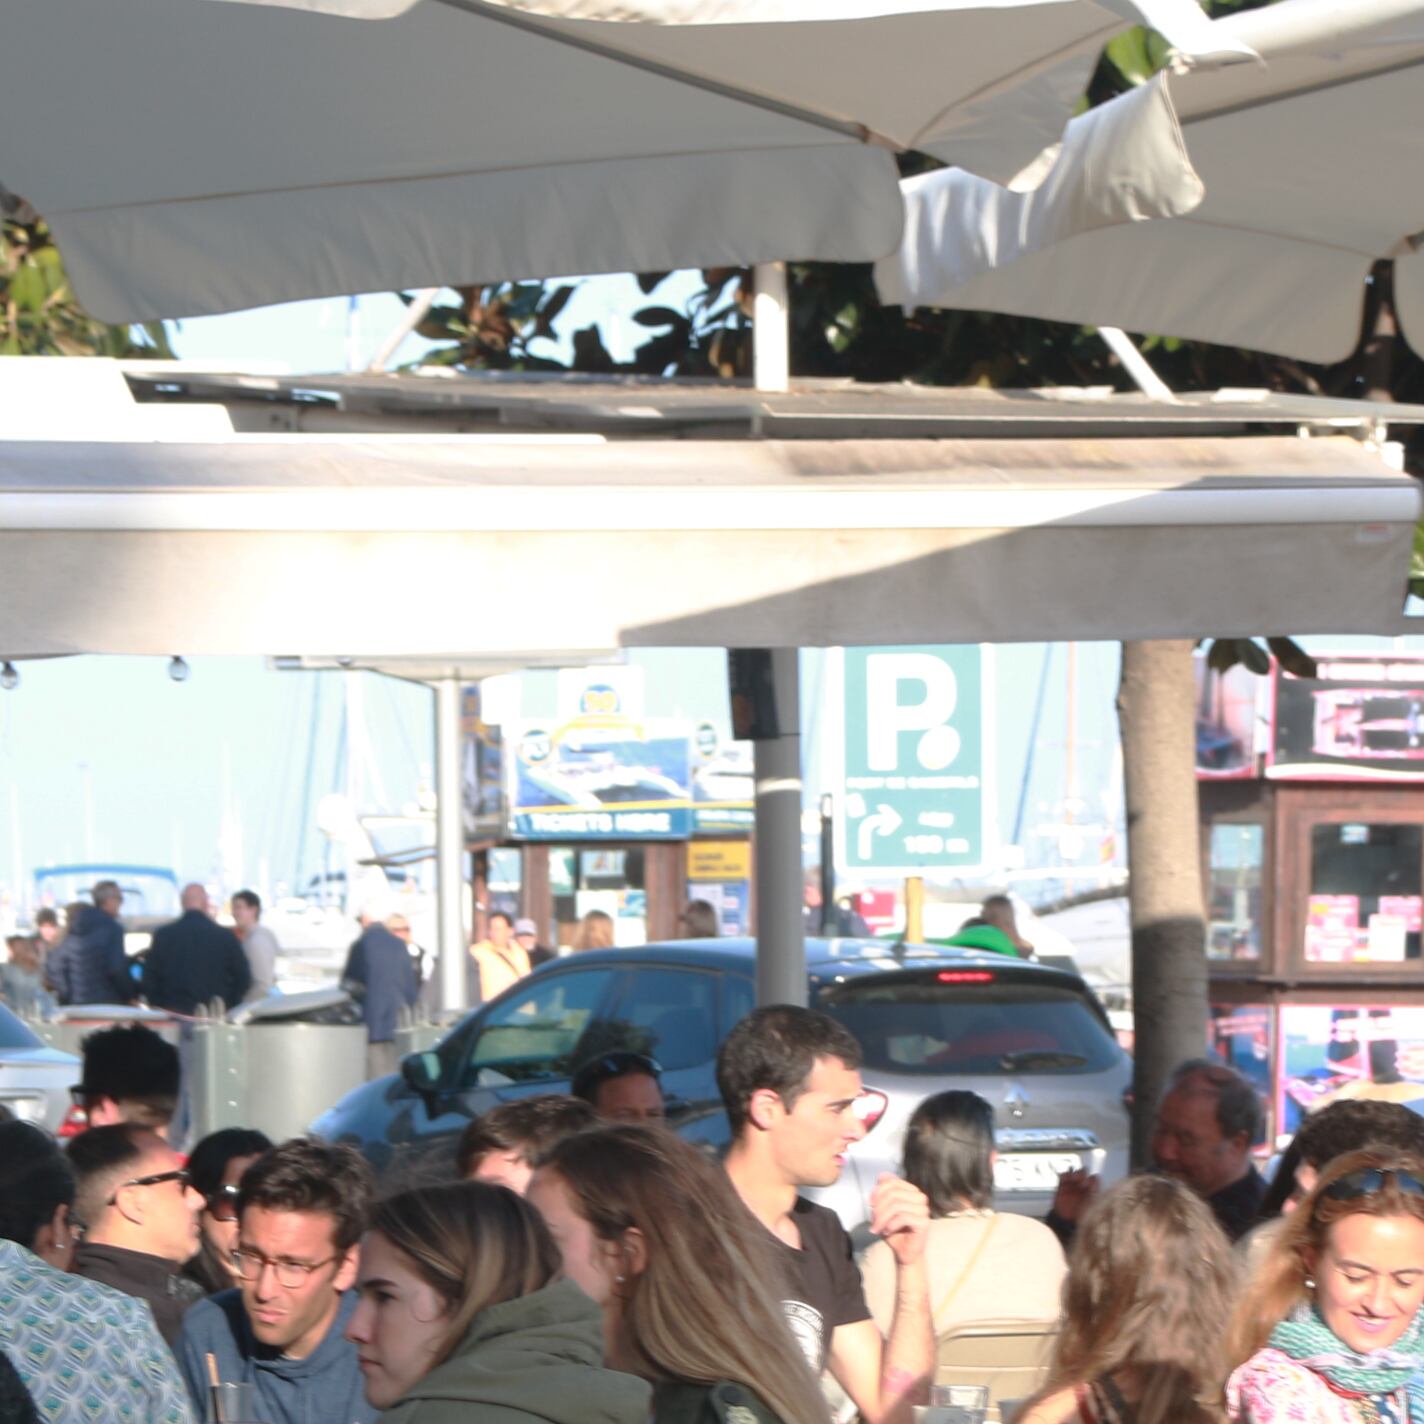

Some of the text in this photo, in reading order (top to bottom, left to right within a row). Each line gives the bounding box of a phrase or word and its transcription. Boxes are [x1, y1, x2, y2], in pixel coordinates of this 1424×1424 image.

[866, 653, 958, 771] P
[530, 812, 670, 832] TICKETS HERE
